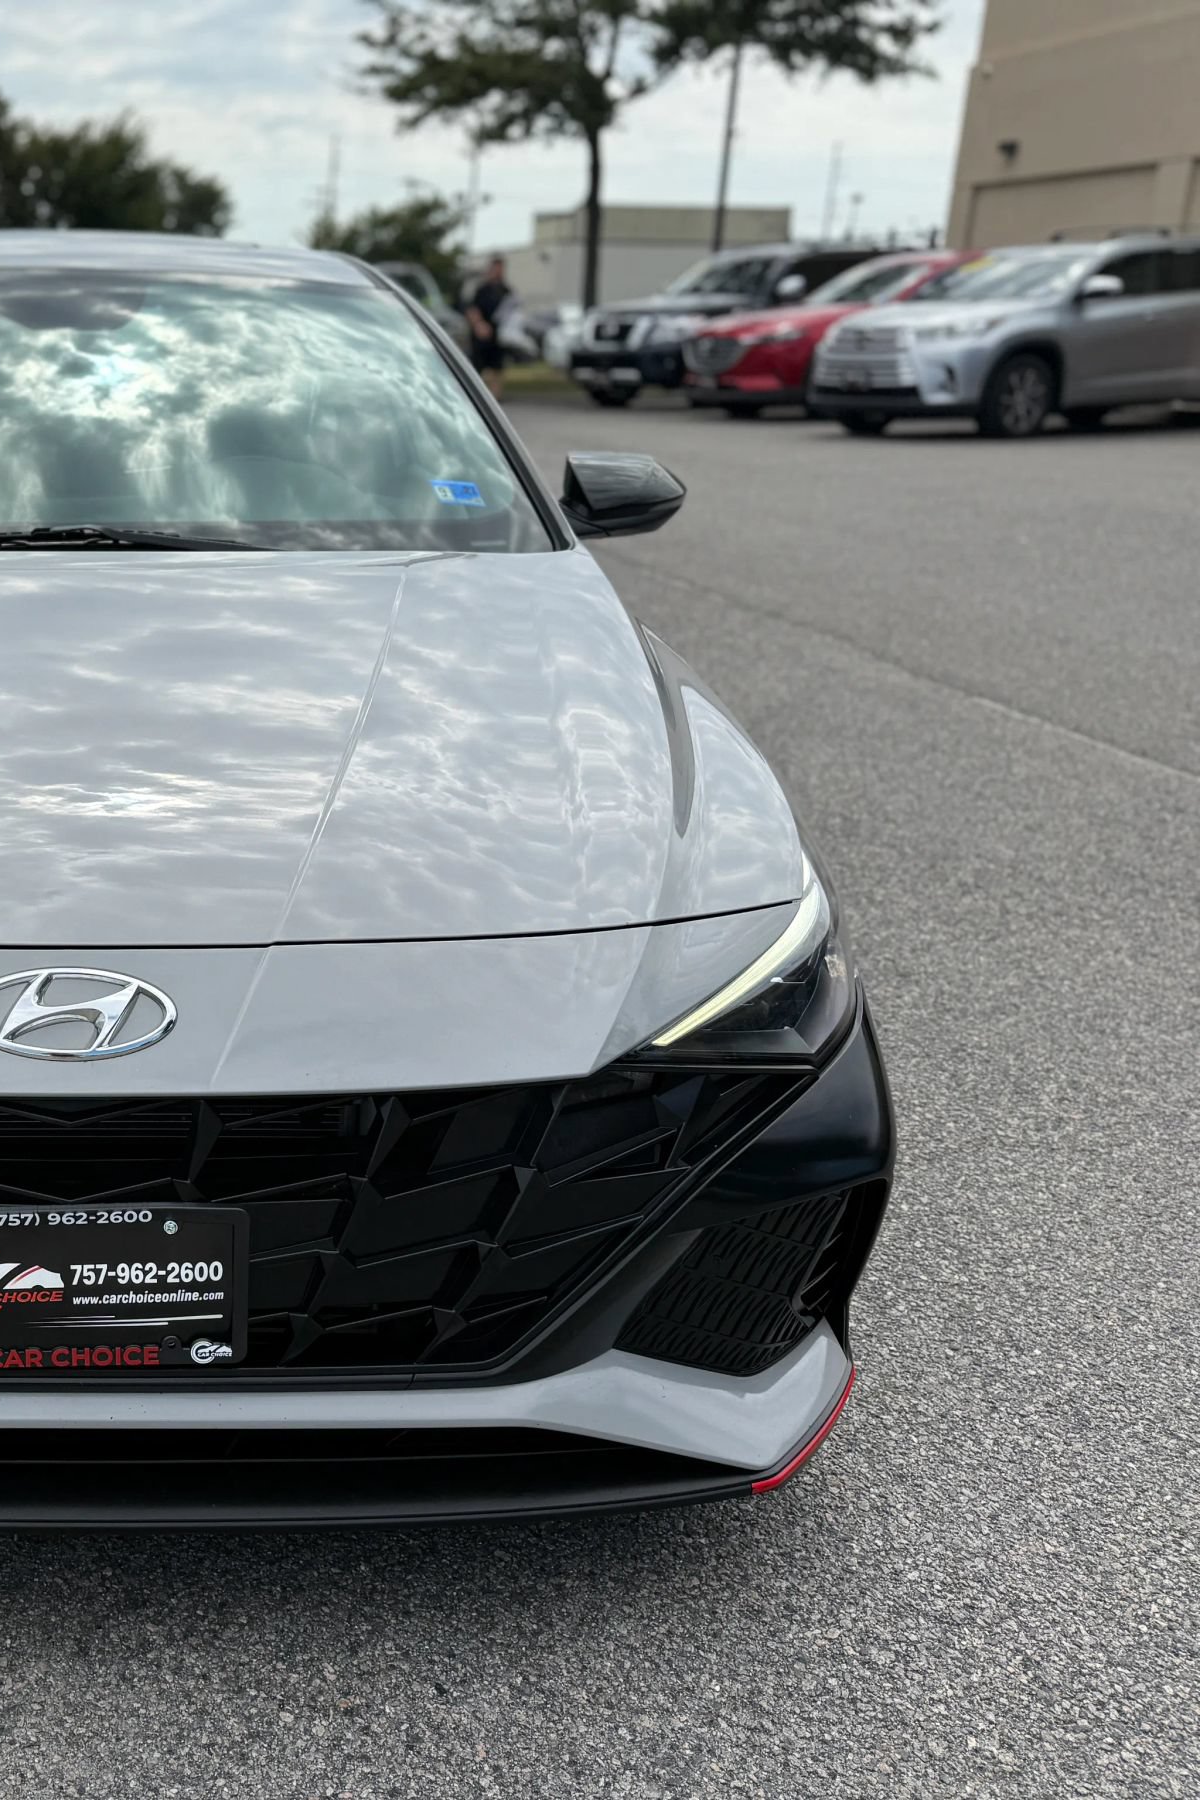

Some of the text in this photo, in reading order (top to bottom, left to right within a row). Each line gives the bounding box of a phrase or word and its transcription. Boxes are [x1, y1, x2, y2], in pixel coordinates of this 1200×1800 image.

[47, 1210, 153, 1226] 962-2600
[69, 1261, 224, 1286] 757-962-2600
[72, 1289, 225, 1306] www.carchoiceonline.com
[51, 1346, 161, 1369] CHOICE
